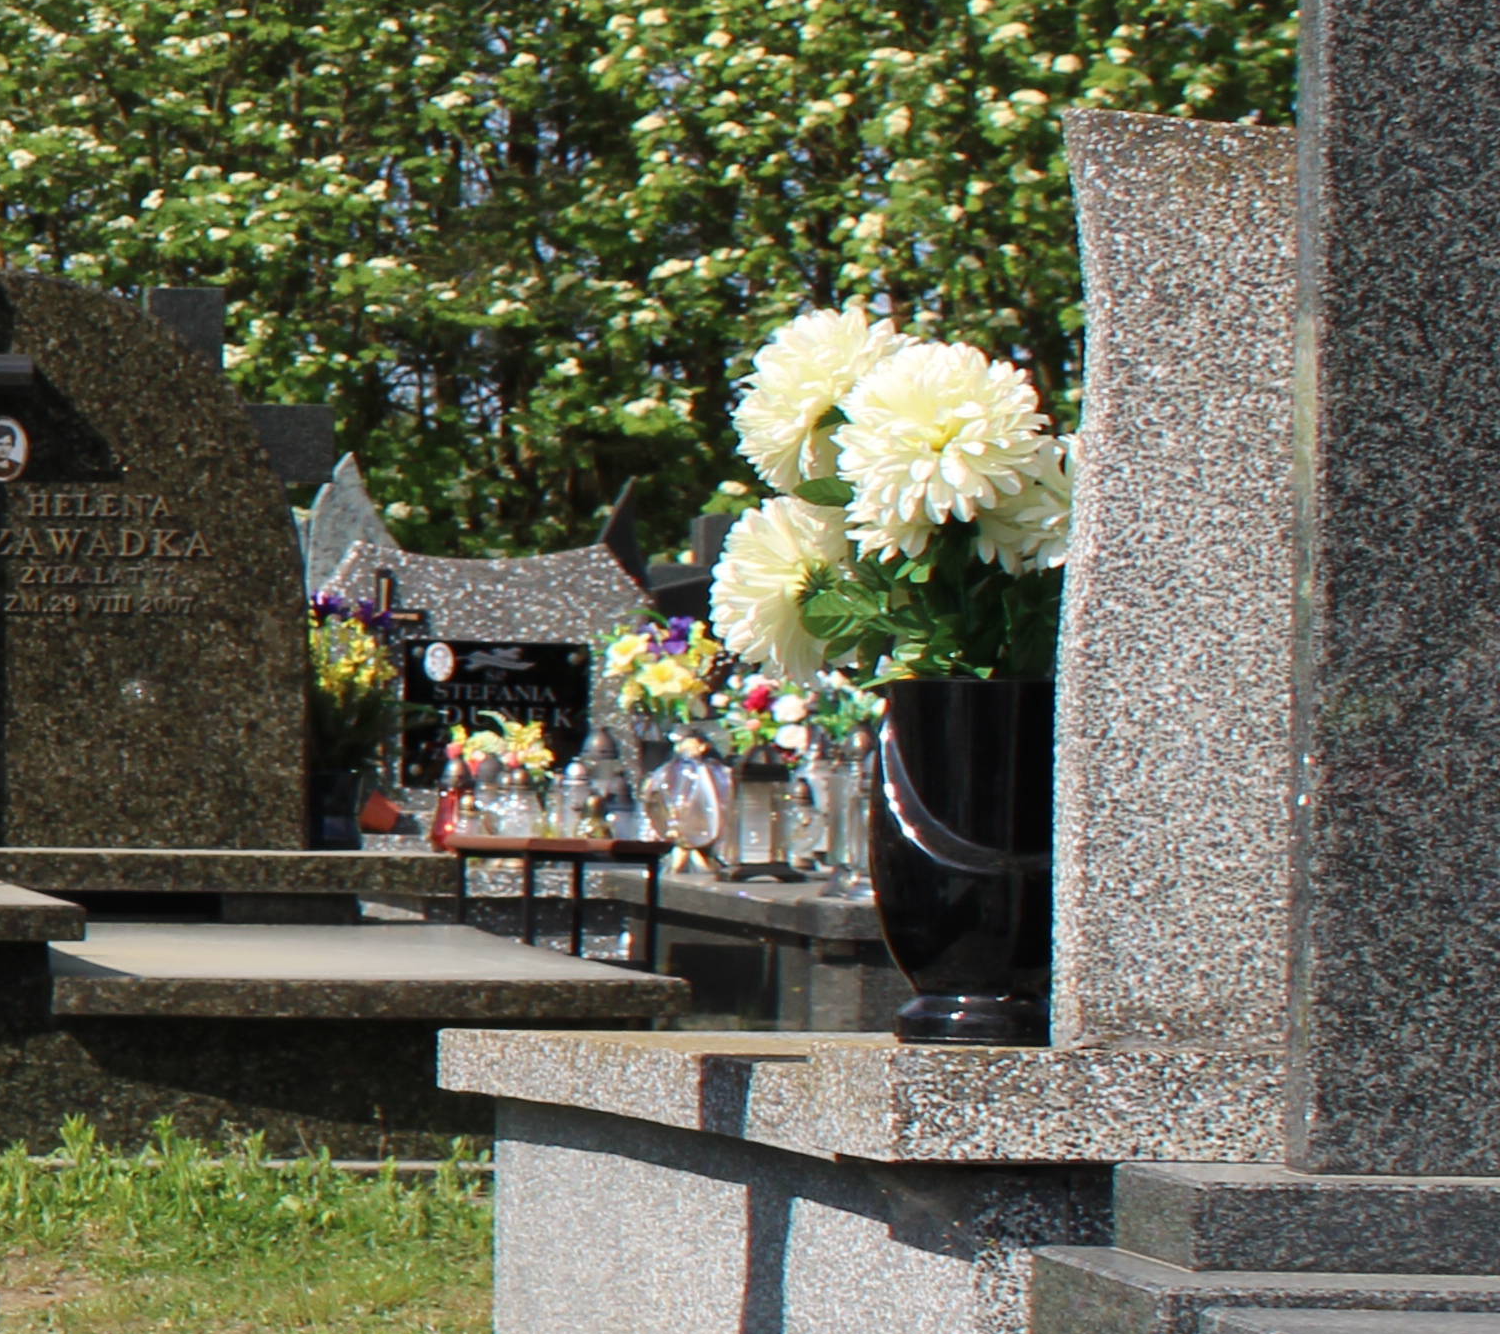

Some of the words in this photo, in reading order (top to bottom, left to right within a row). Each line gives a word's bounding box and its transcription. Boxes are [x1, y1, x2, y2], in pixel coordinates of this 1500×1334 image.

[27, 493, 173, 517] HELENA
[95, 565, 141, 584] LAT
[433, 684, 557, 703] STEFANIA
